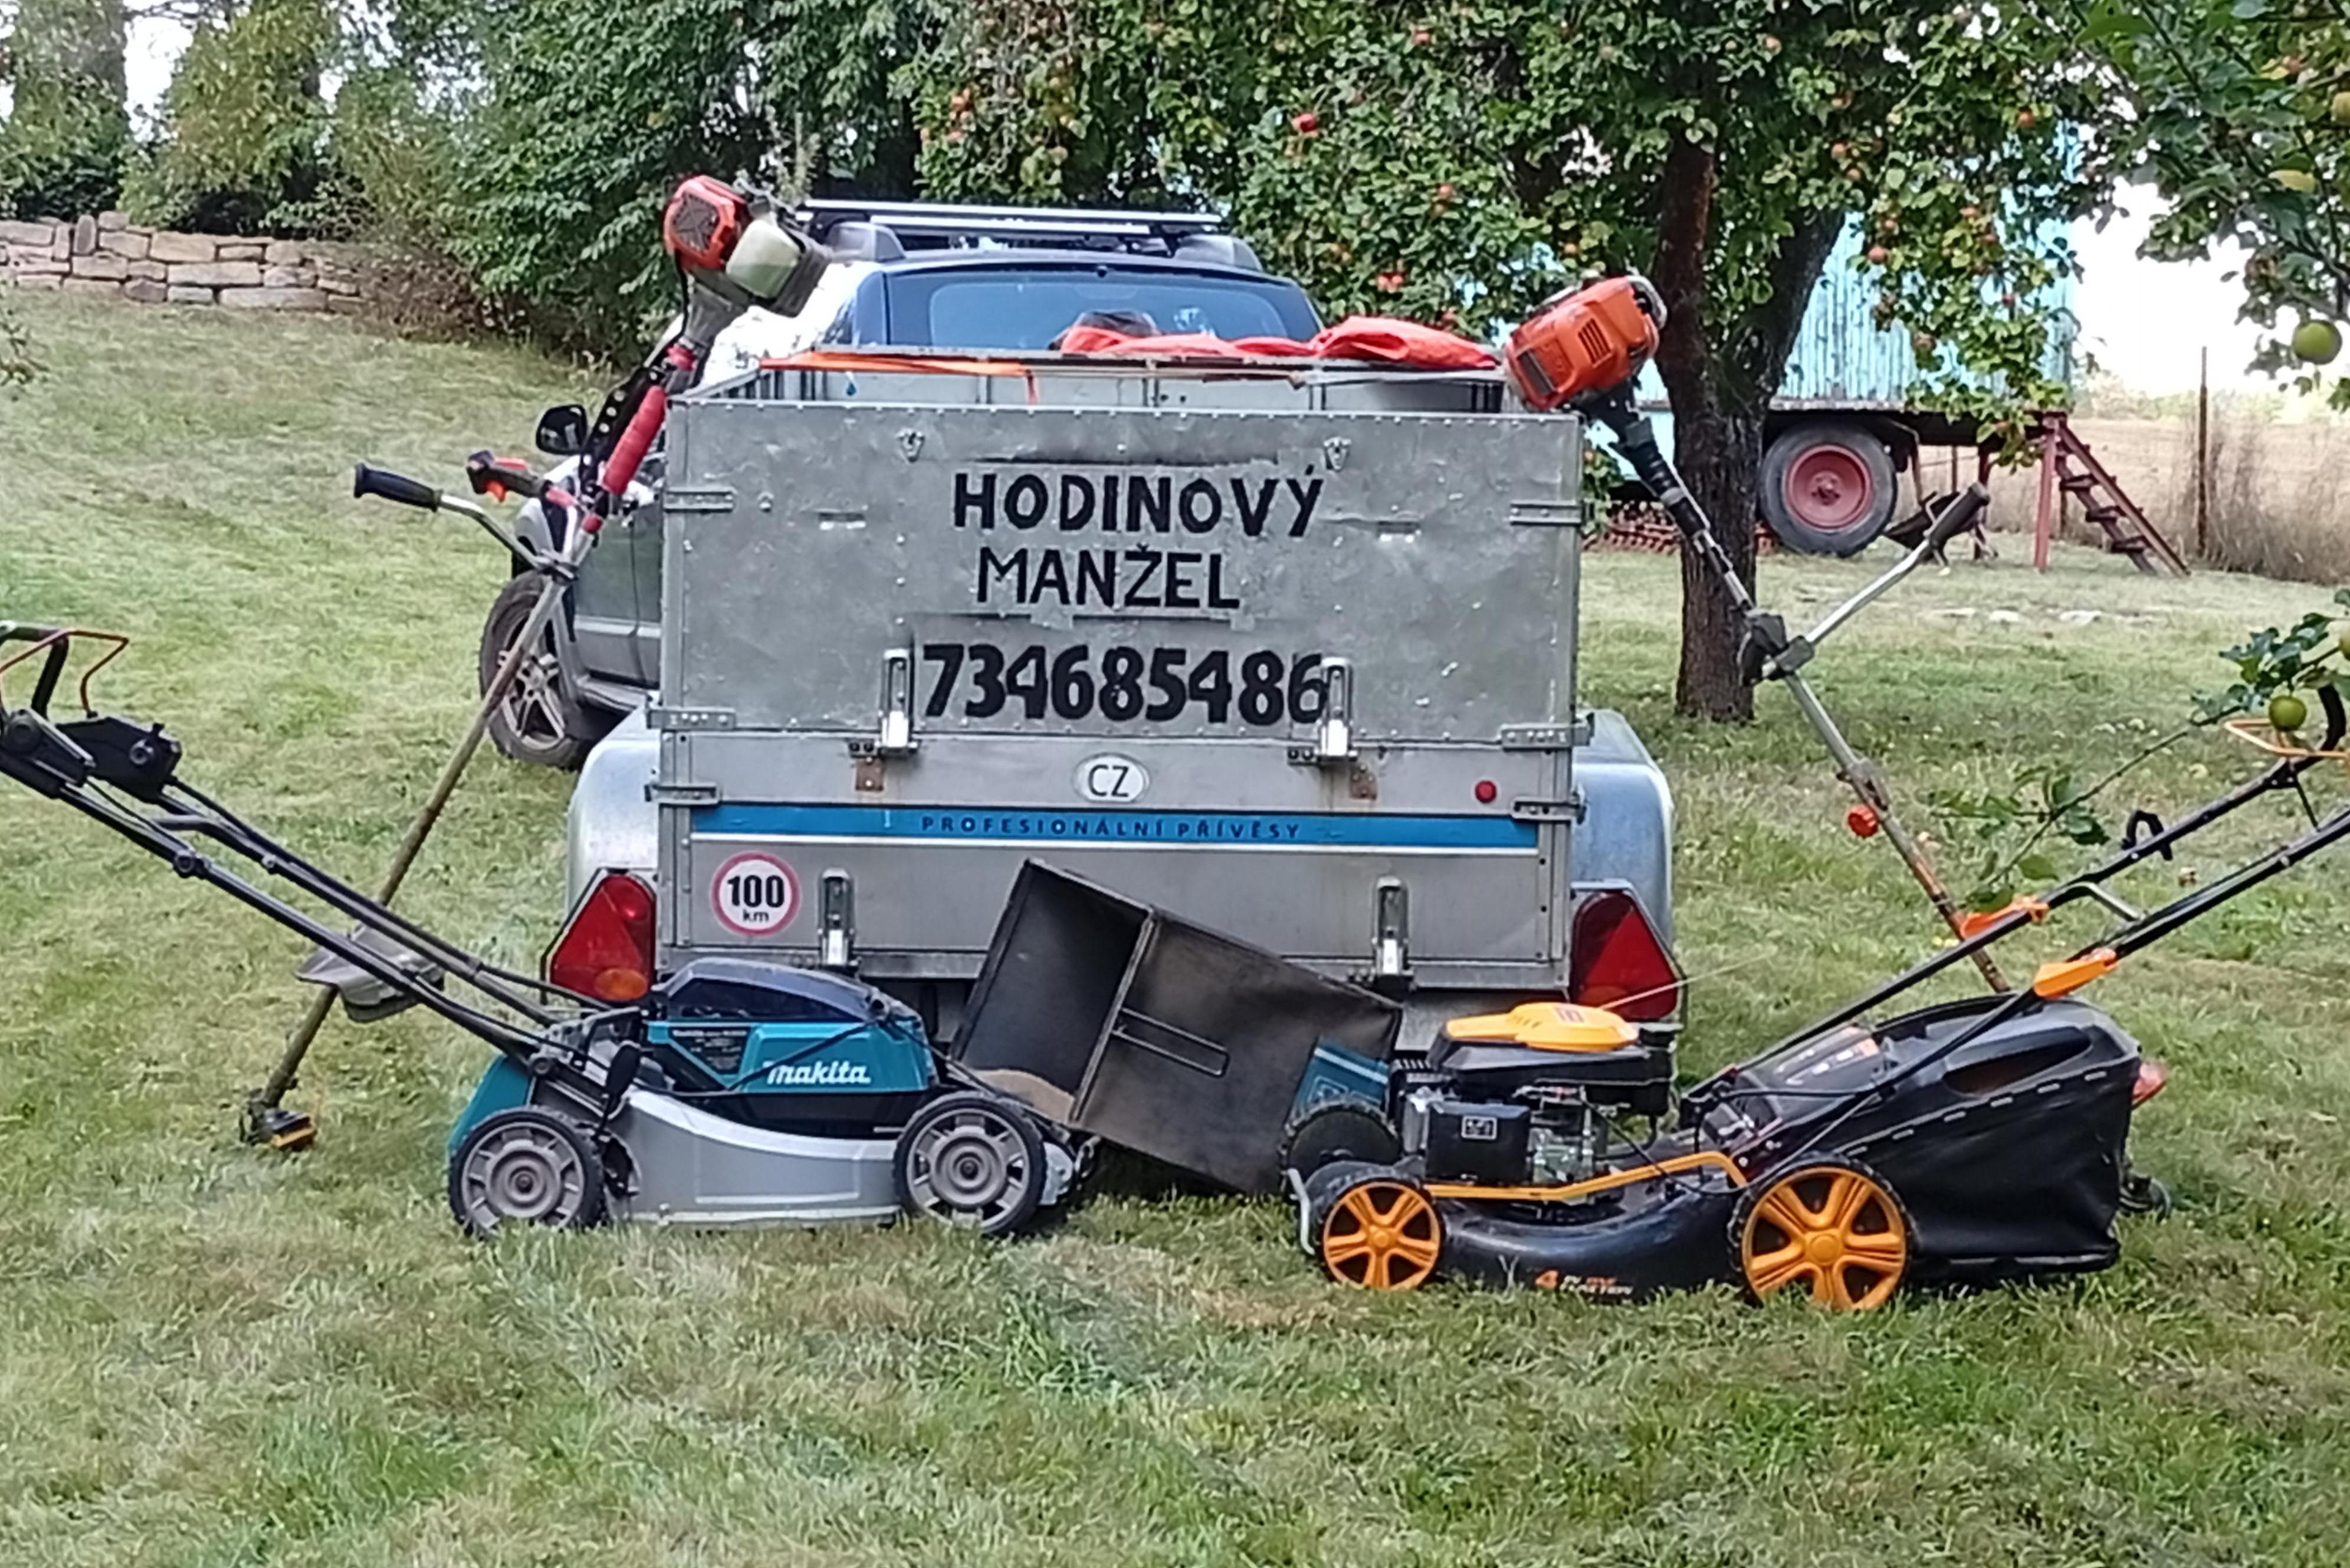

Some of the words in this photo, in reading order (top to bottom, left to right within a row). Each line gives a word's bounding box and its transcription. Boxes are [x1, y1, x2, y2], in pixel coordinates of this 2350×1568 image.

[954, 464, 1324, 537] HODINOVÝ
[977, 543, 1240, 609] MANŽEL
[923, 643, 1328, 726] 734685486
[1088, 764, 1129, 797] CZ
[921, 816, 1164, 837] PROFESIONÁLNÍ
[1177, 819, 1299, 839] PŘÍVĚSY
[727, 875, 785, 908] 100
[743, 909, 770, 922] km
